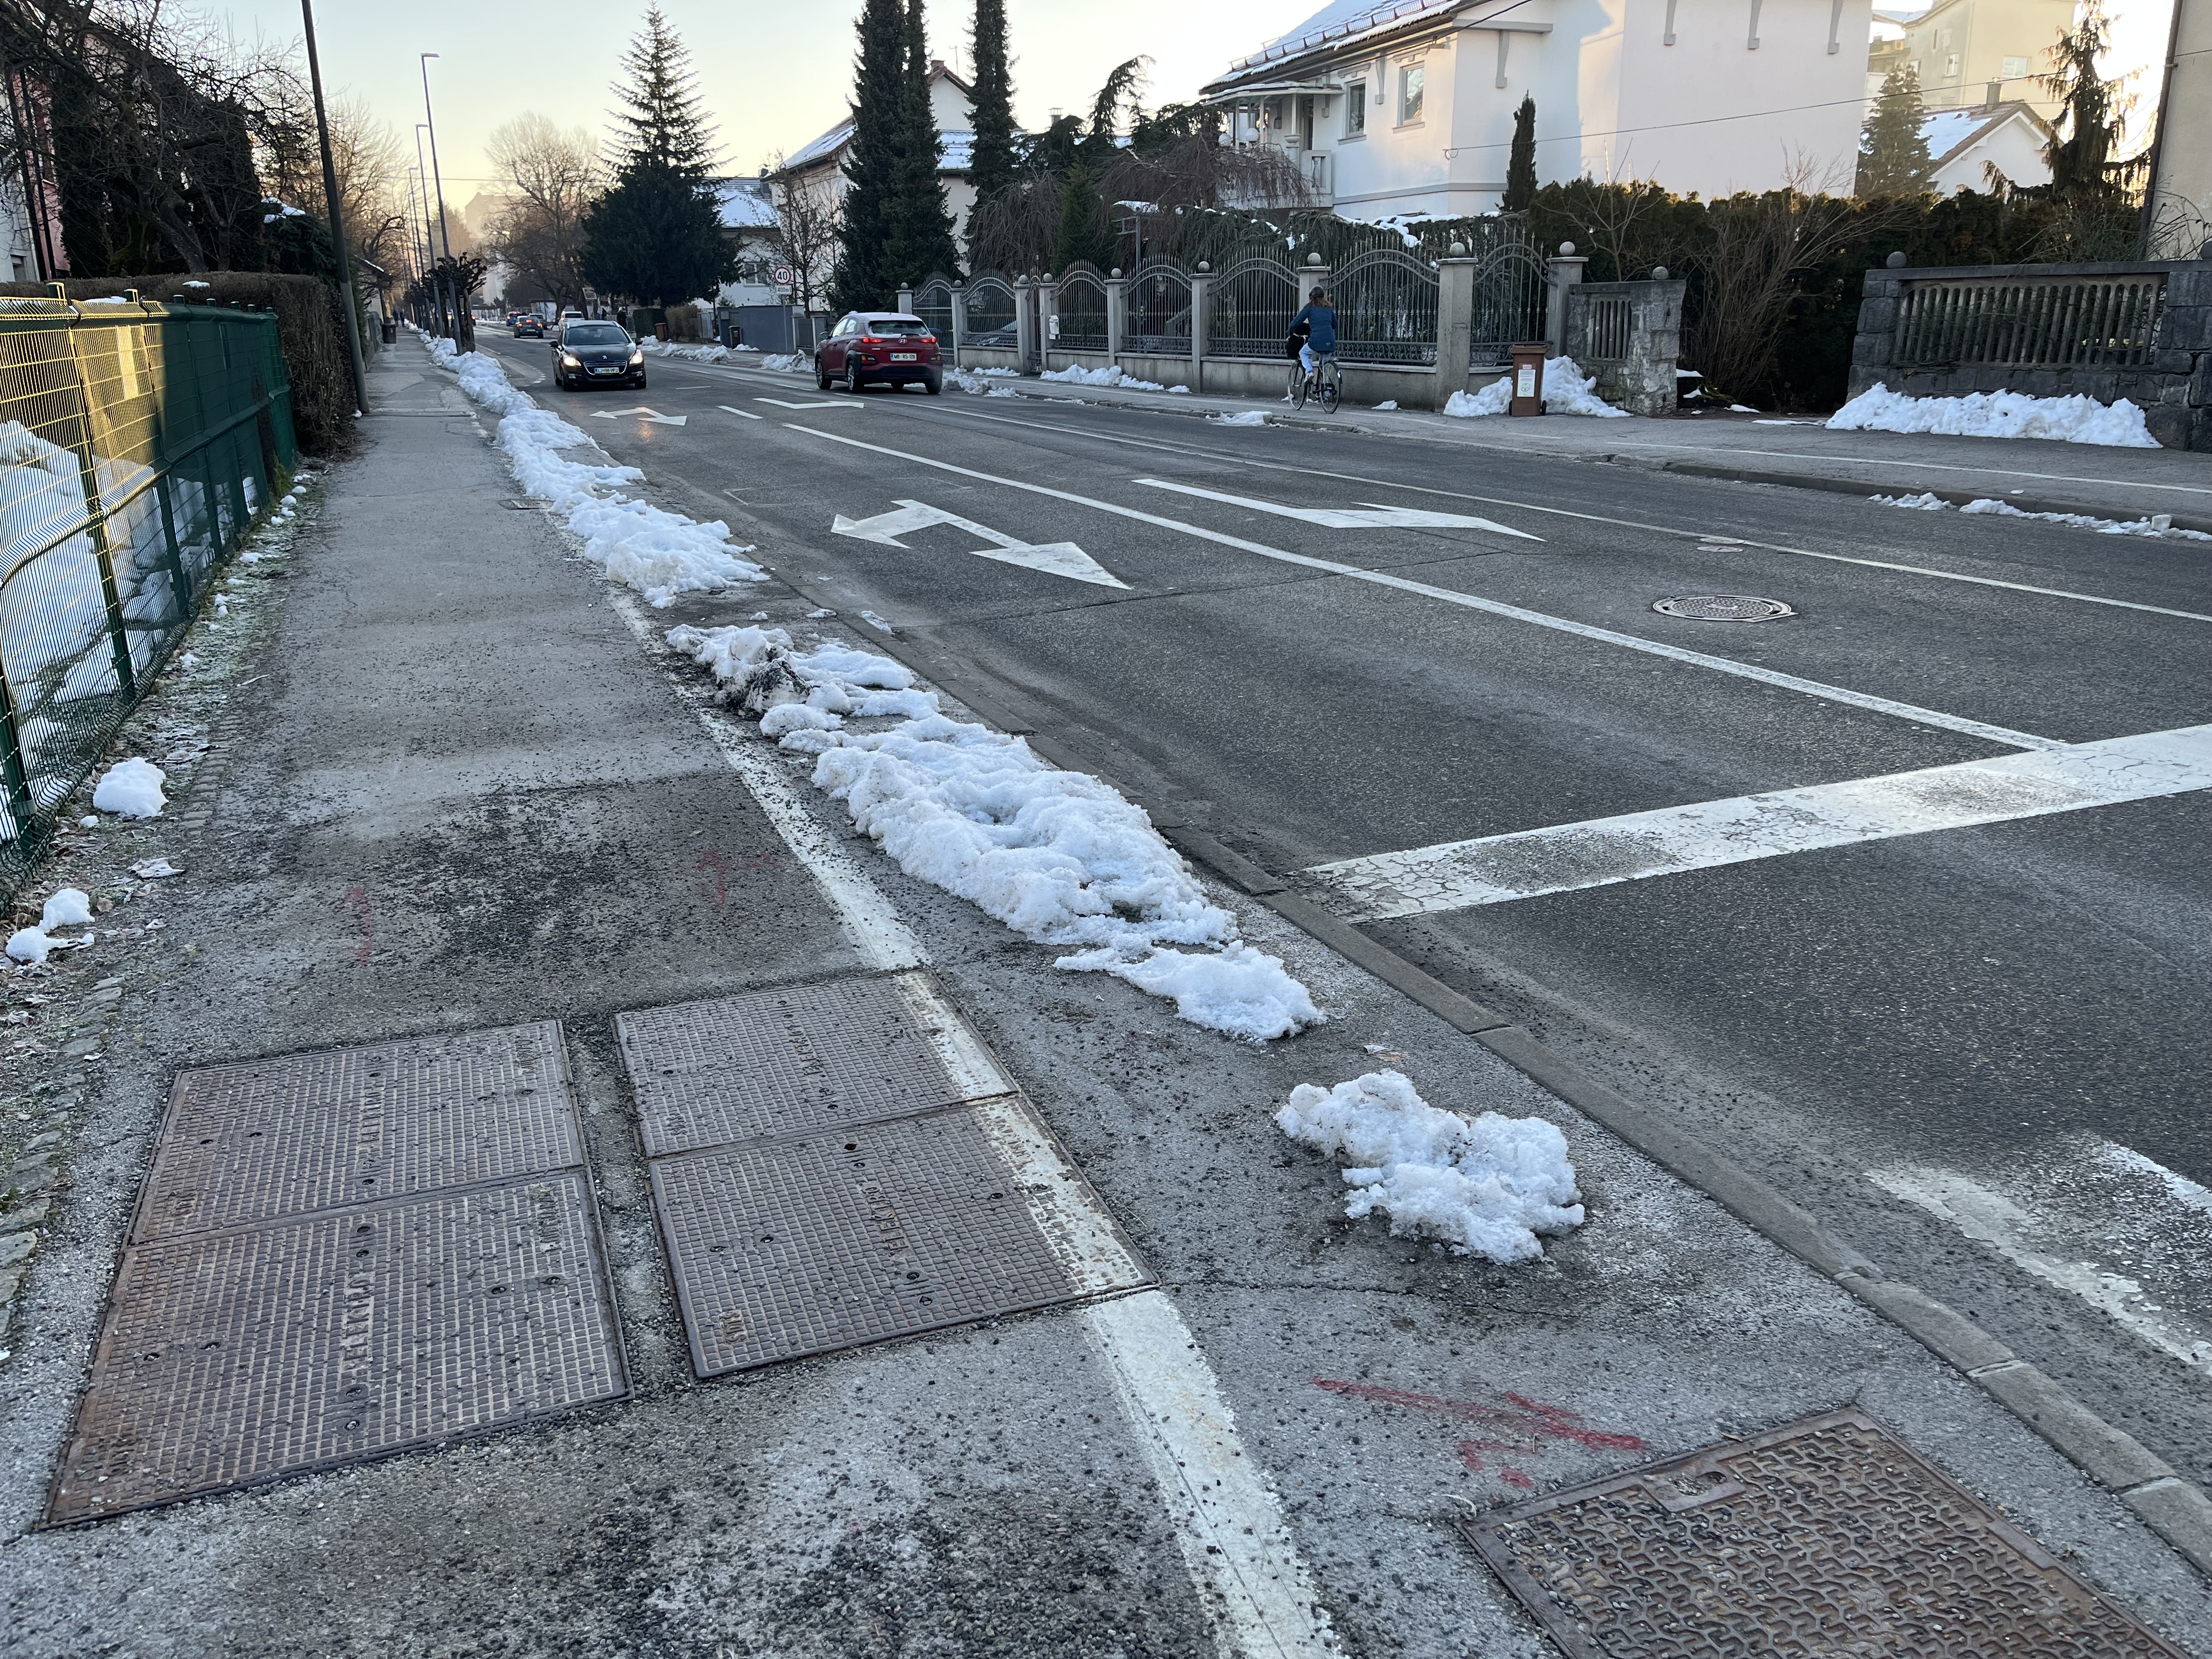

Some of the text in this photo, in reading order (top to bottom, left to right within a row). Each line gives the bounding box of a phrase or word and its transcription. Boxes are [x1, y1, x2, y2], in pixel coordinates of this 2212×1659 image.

[777, 272, 787, 280] 40
[860, 1184, 909, 1251] ELEKTRO
[344, 1277, 370, 1362] ELEKTRO
